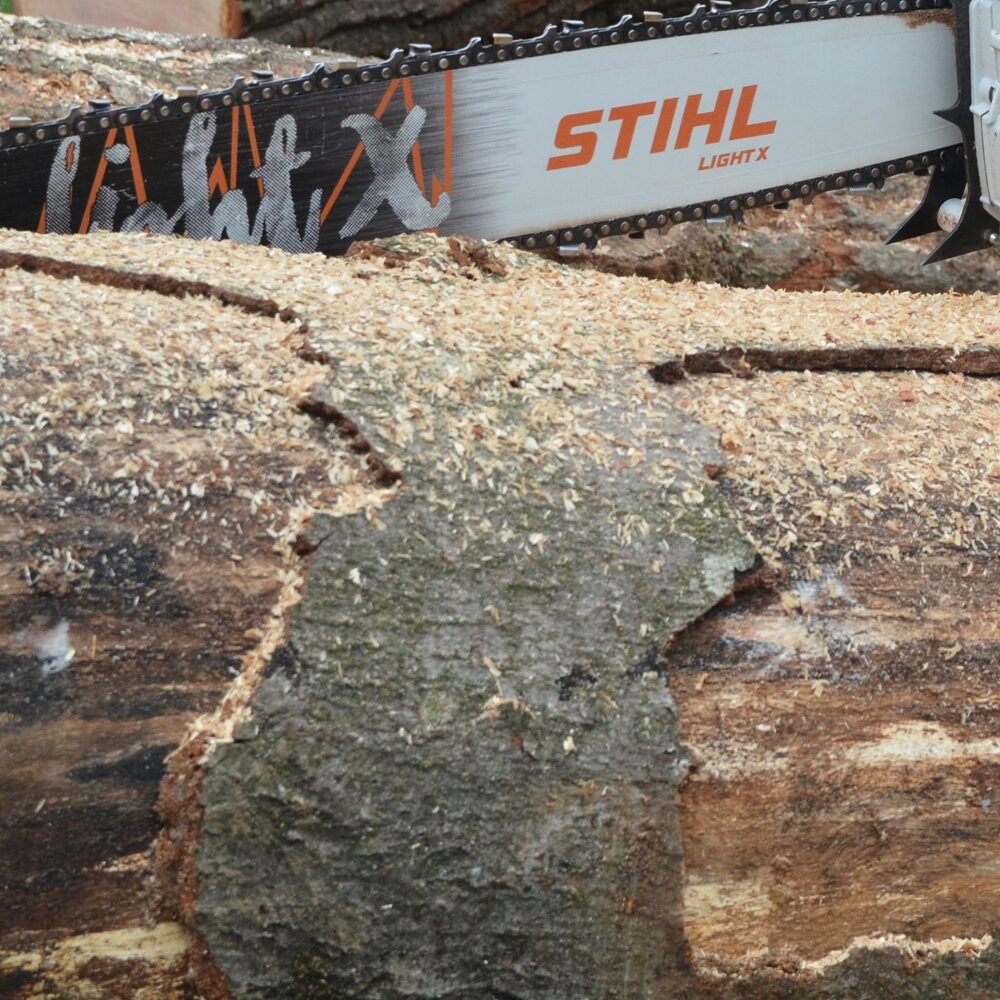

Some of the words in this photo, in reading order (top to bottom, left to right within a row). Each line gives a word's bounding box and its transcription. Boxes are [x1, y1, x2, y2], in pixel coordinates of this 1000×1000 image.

[546, 84, 777, 171] STIHL
[698, 148, 756, 171] LIGHT
[755, 145, 770, 161] X
